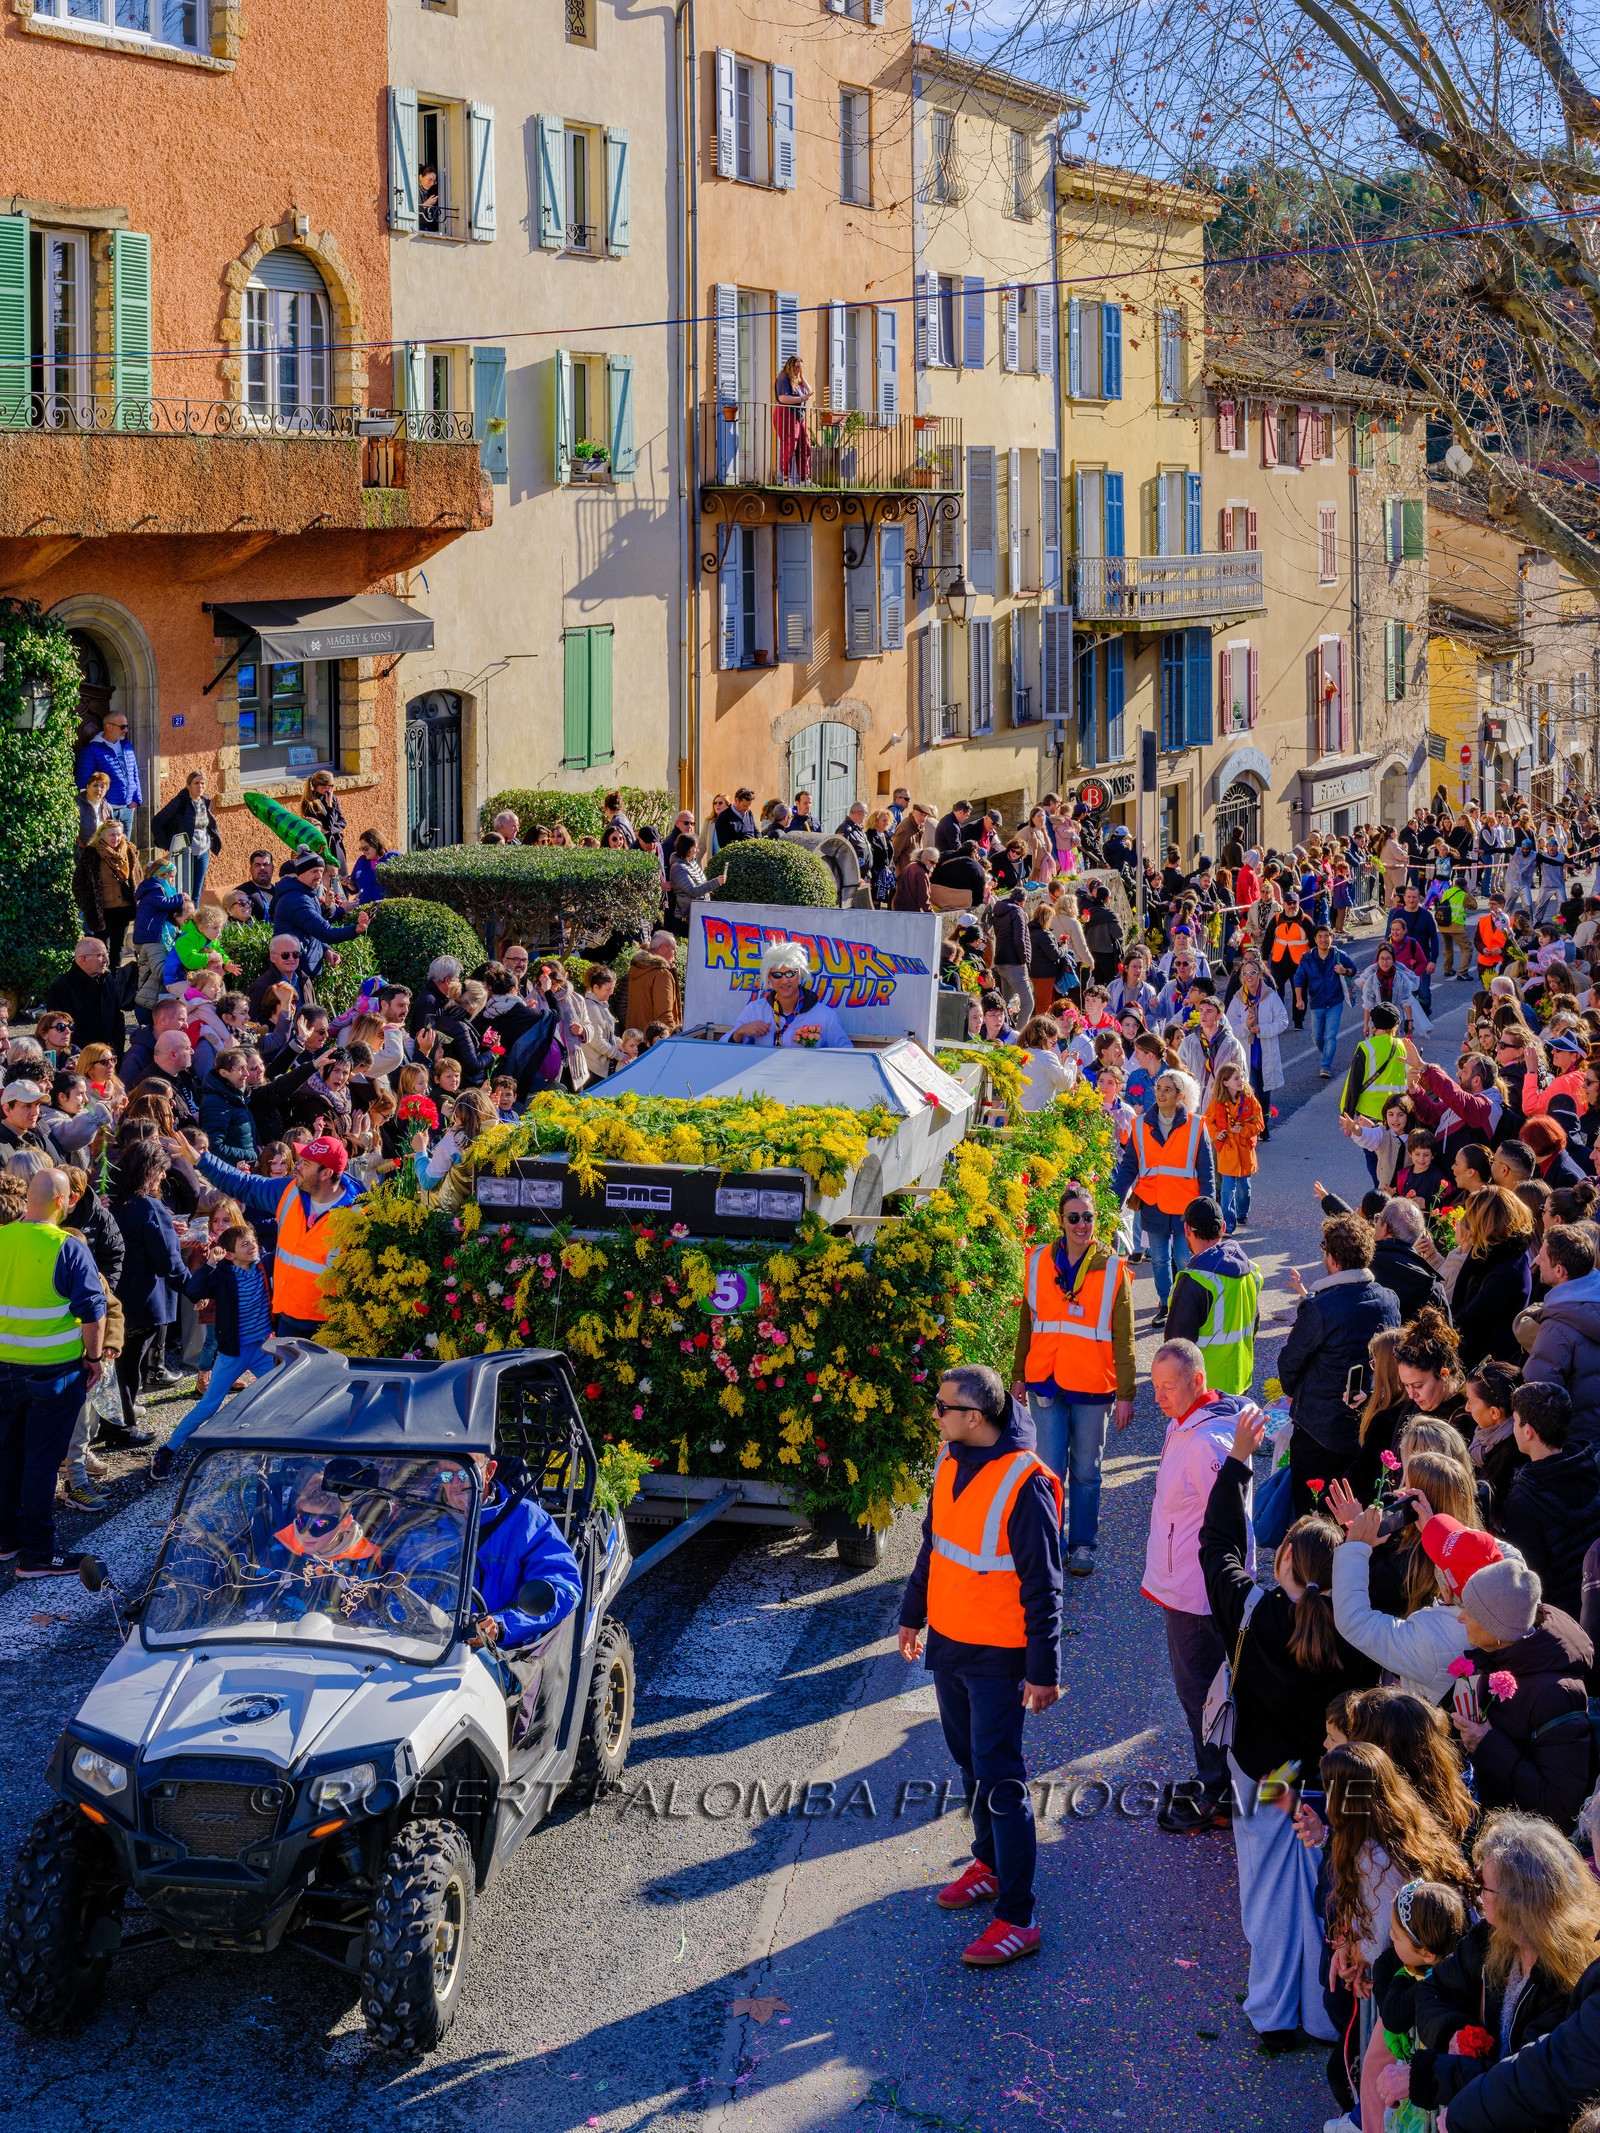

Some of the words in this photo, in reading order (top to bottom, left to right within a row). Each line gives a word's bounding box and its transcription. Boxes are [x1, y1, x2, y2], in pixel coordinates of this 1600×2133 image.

[326, 633, 361, 646] MAGREY
[362, 632, 369, 643] &
[370, 631, 392, 643] SONS
[175, 717, 183, 725] 27
[1081, 779, 1105, 791] BARNES
[1087, 788, 1099, 806] B
[729, 970, 774, 991] VER
[801, 976, 897, 1008] UTUR
[713, 1273, 739, 1309] 5
